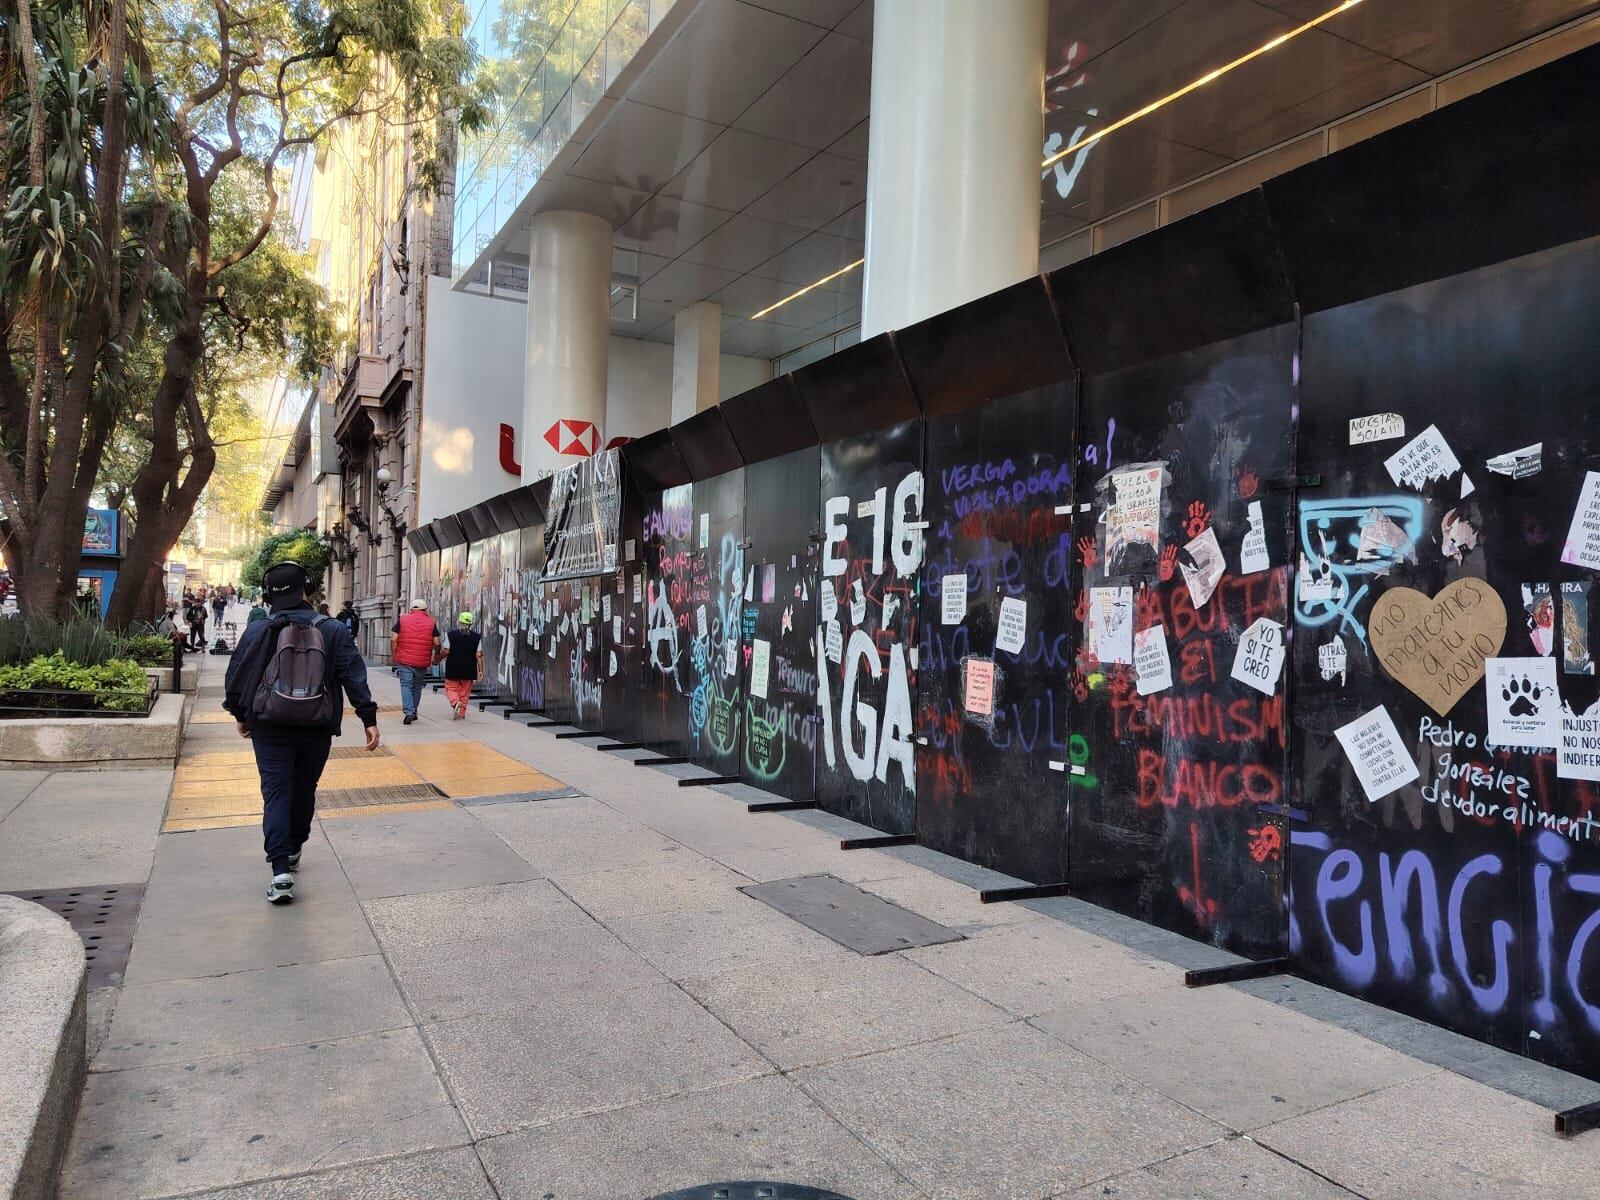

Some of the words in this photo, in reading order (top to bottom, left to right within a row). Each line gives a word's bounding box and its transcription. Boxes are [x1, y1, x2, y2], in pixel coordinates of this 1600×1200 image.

[1416, 438, 1430, 452] QUE
[1399, 460, 1422, 478] MATAR
[1421, 451, 1431, 464] NO
[1431, 444, 1441, 456] ES
[942, 459, 1016, 495] VERGA
[1413, 461, 1439, 482] PECADO
[1583, 510, 1600, 521] EXPL
[1259, 623, 1275, 643] YO
[1245, 638, 1258, 654] SI
[1260, 643, 1272, 663] TE
[1320, 643, 1346, 656] OTRAS
[1243, 656, 1270, 681] CREO
[1326, 656, 1336, 668] TE
[1360, 722, 1381, 737] MUJERES
[1418, 715, 1477, 749] Pedro
[1562, 718, 1599, 732] INJUST
[1359, 738, 1393, 761] COMPETENCIA
[1562, 735, 1577, 747] NO
[1563, 752, 1600, 767] INDIFER
[1390, 764, 1407, 778] ELLAS
[1421, 778, 1500, 818] deudor
